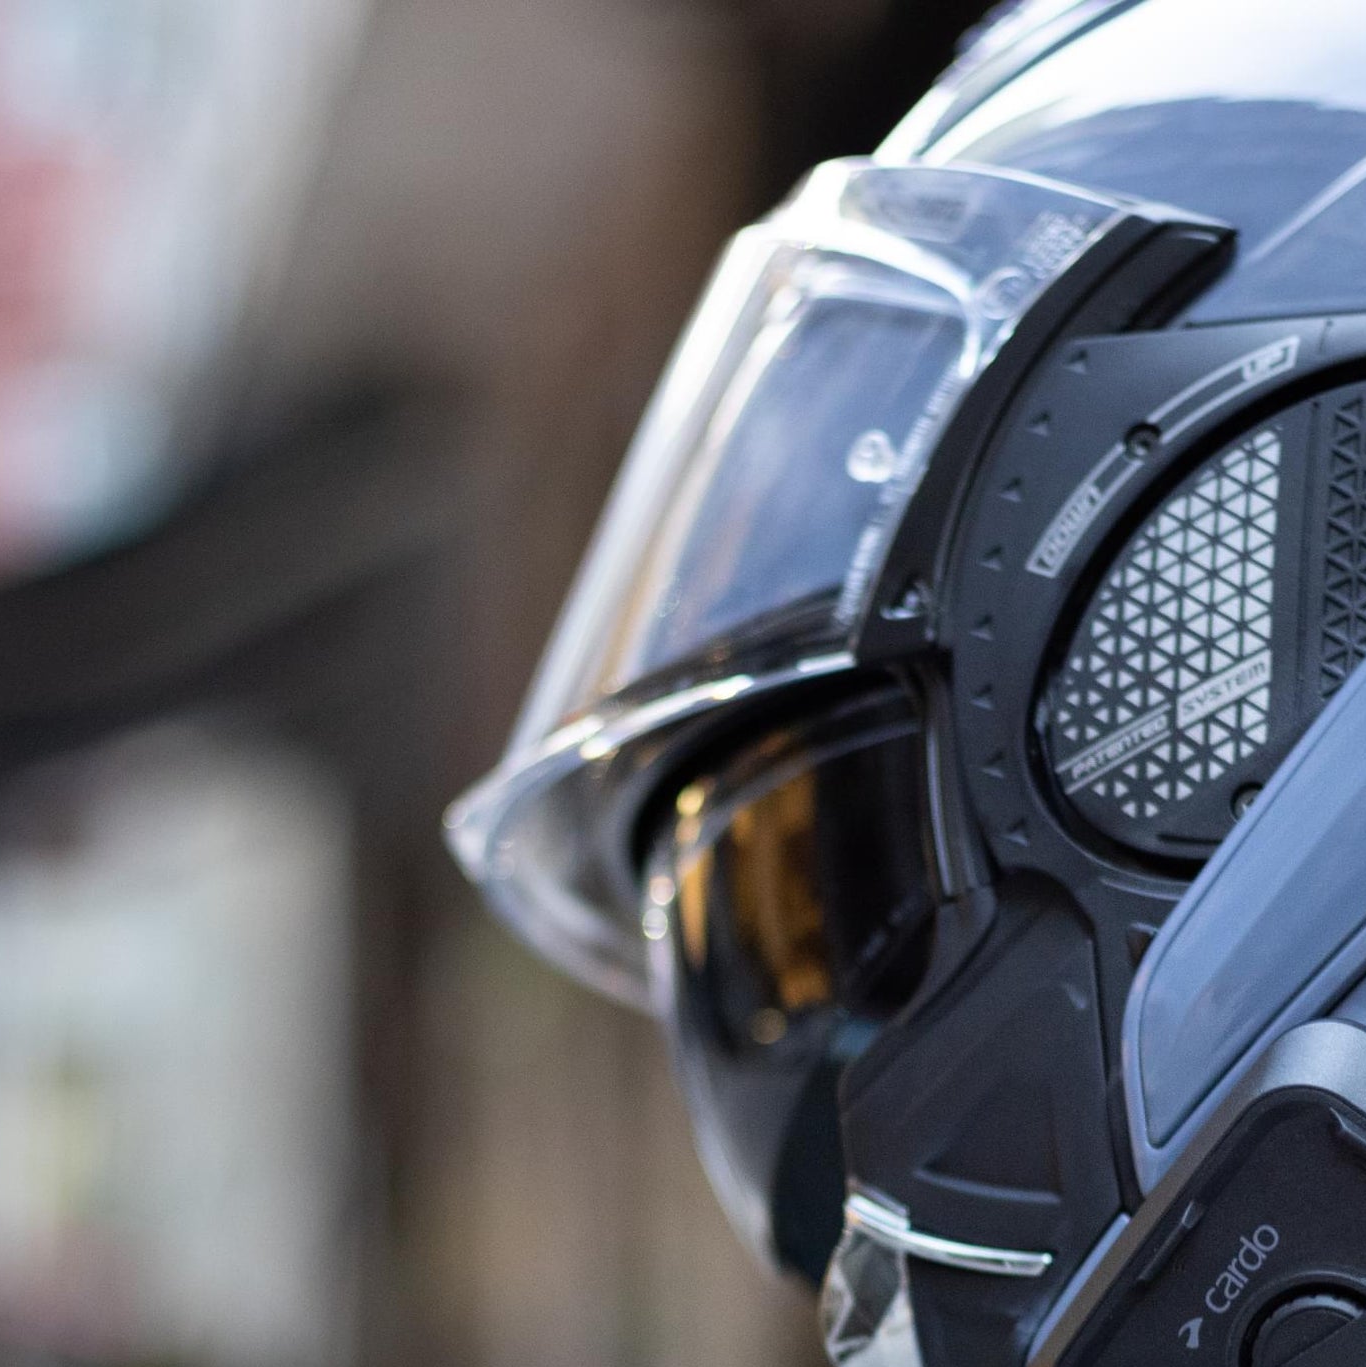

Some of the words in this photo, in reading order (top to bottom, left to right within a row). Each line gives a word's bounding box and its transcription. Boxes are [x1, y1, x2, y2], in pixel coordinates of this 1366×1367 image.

[1070, 713, 1167, 780] PATENTED
[1181, 659, 1267, 716] SYSTEM
[1205, 1224, 1279, 1313] cardo
